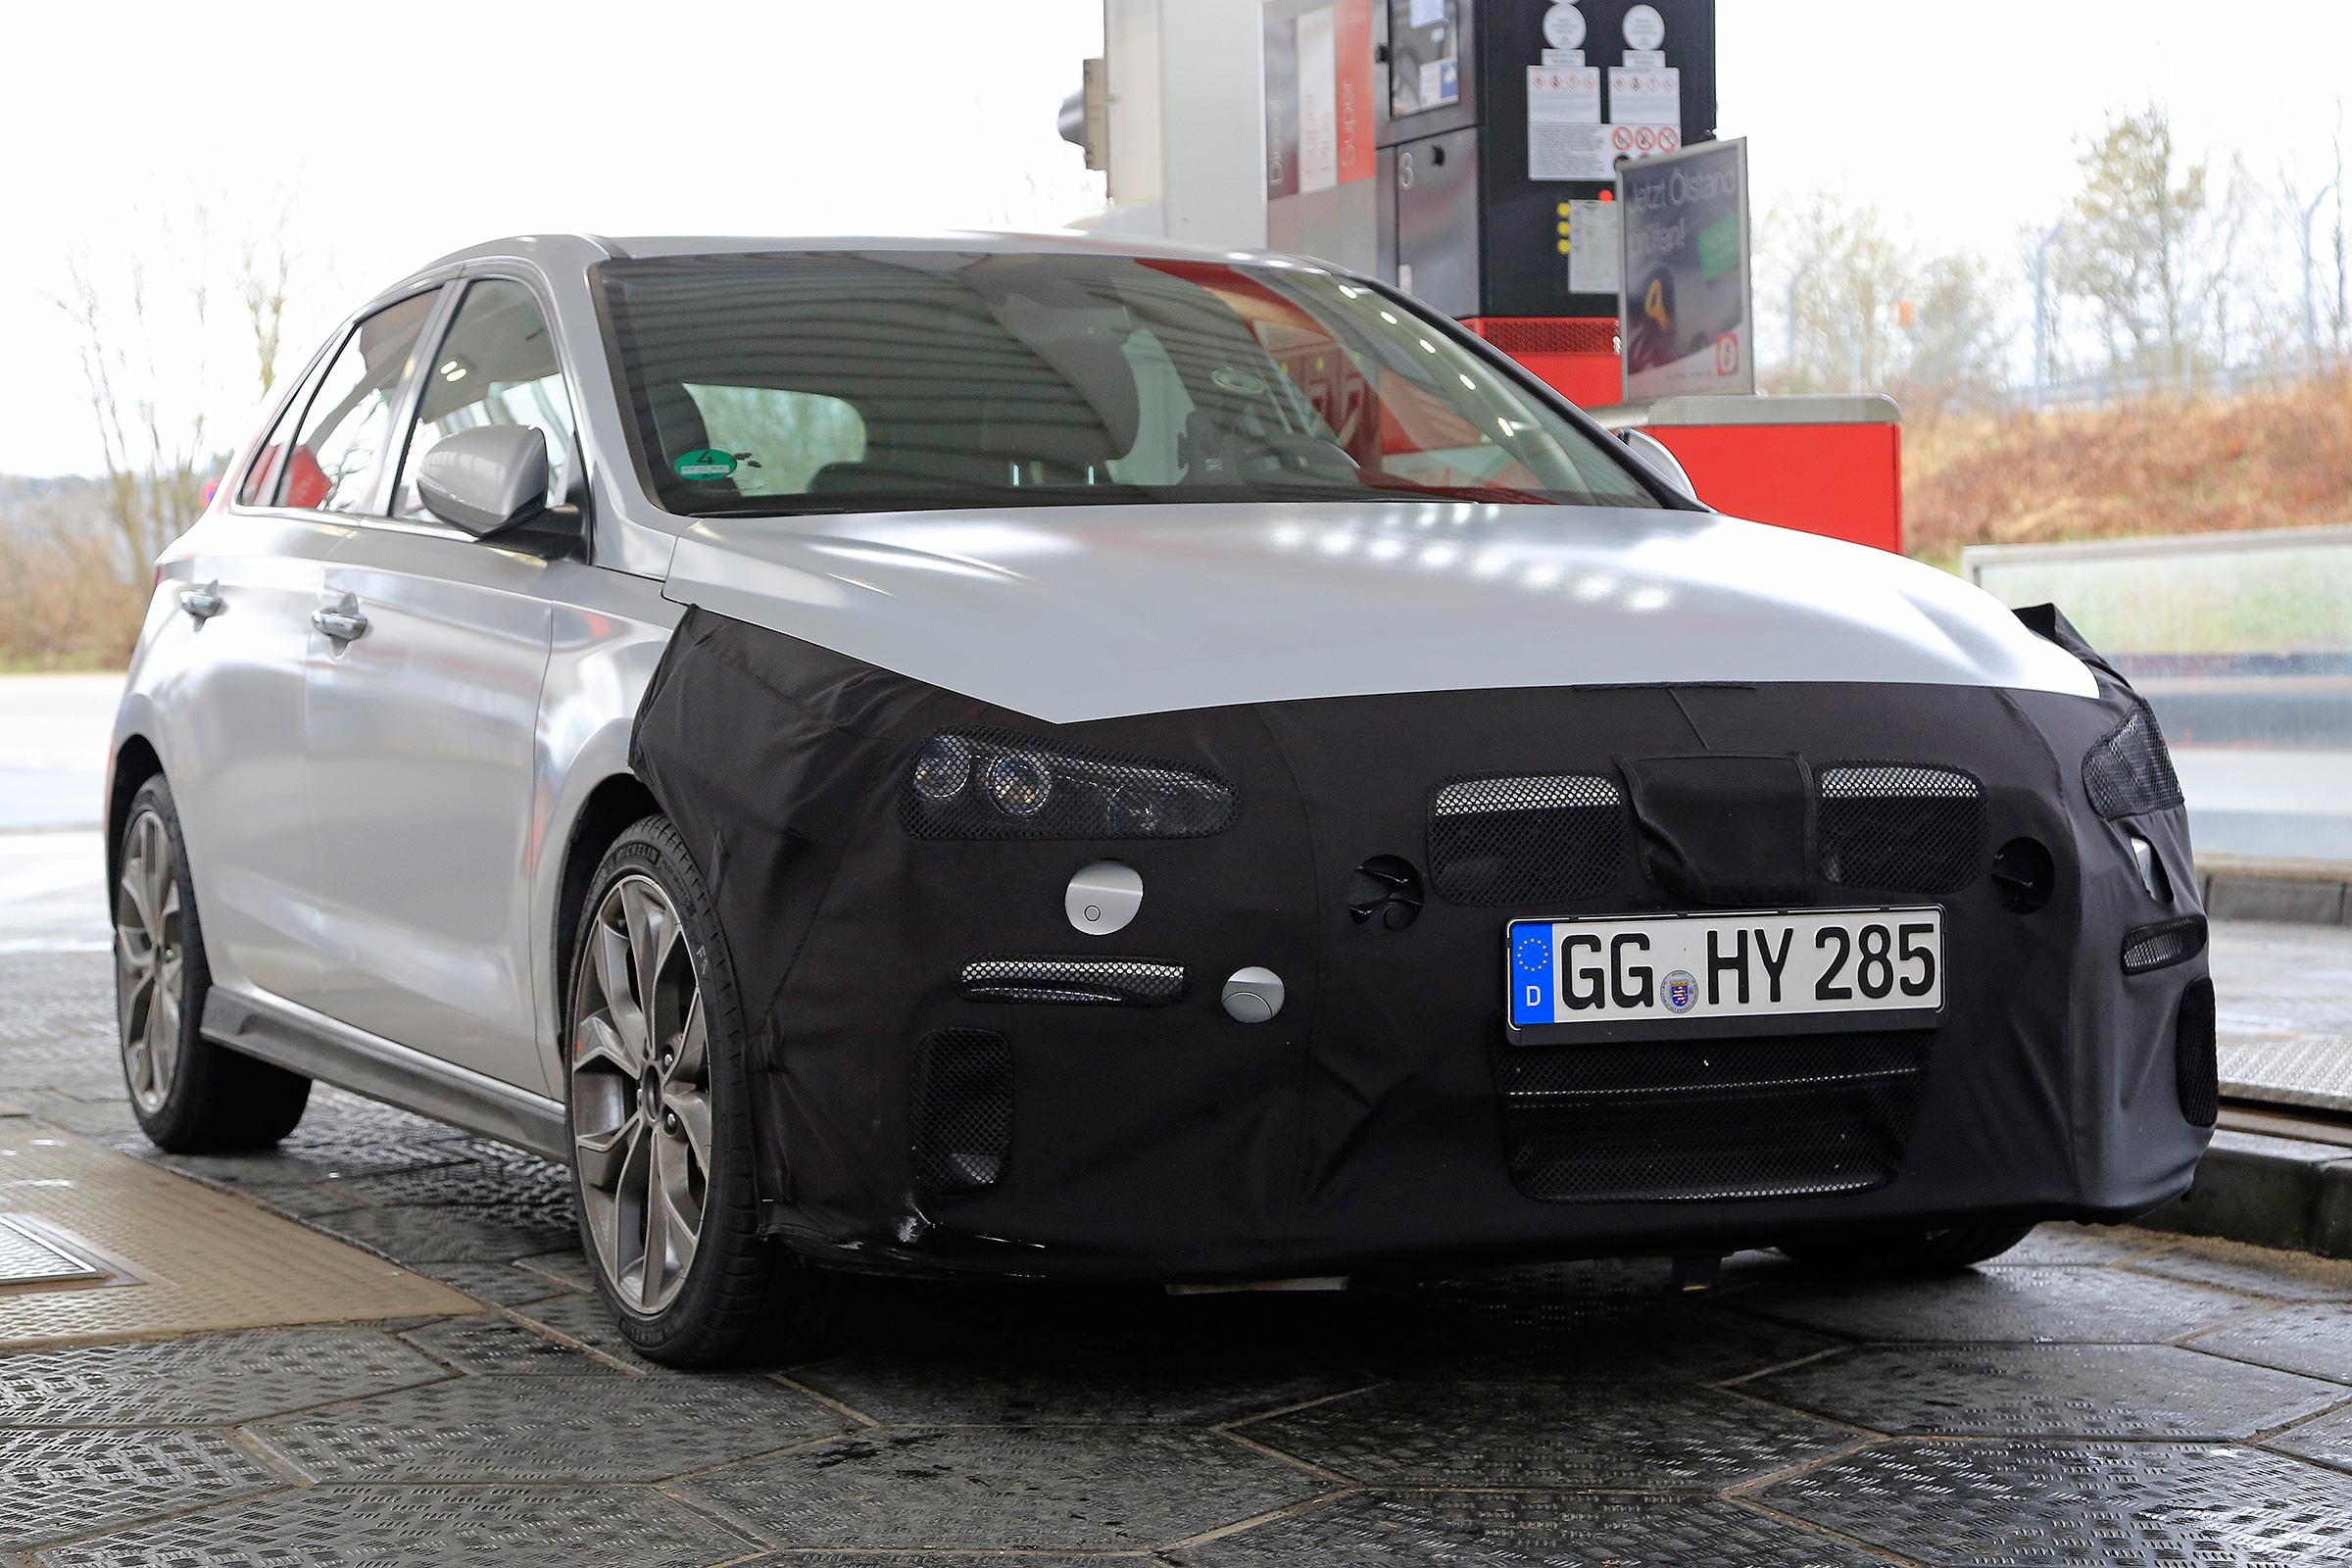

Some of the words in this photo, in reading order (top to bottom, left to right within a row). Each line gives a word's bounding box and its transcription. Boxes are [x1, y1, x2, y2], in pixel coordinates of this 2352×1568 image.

[1398, 152, 1413, 190] 3
[697, 451, 714, 465] 4
[615, 843, 660, 864] MICHELIN
[1560, 933, 1654, 1010] GG
[1706, 927, 1793, 1005] HY
[1814, 923, 1936, 1002] 285
[1526, 985, 1542, 1007] D
